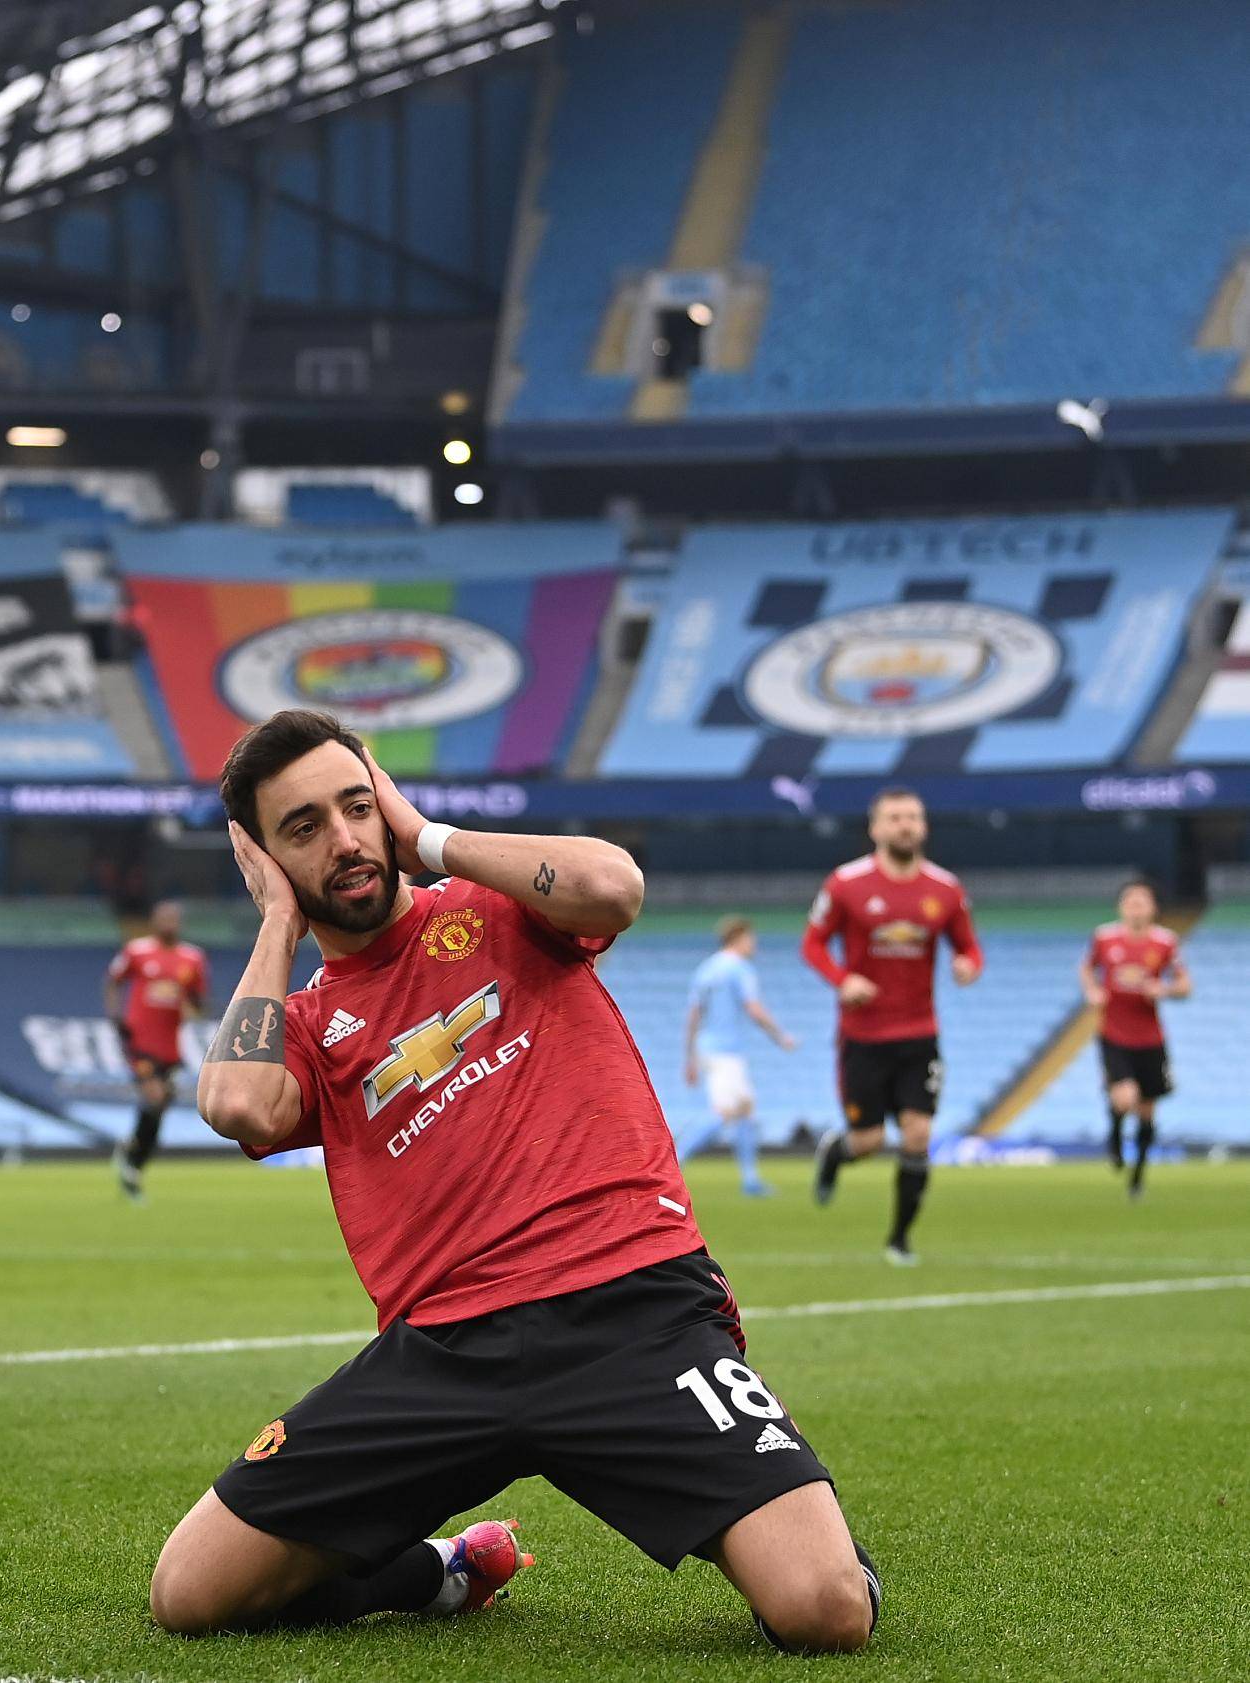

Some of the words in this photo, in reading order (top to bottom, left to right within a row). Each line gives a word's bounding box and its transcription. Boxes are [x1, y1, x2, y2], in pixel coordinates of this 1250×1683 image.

[533, 861, 556, 897] 23
[426, 911, 473, 943] MANCHESTER
[322, 1018, 366, 1048] adidas
[386, 1029, 532, 1158] CHEVROLET
[675, 1357, 784, 1432] 18
[754, 1439, 801, 1454] adidas
